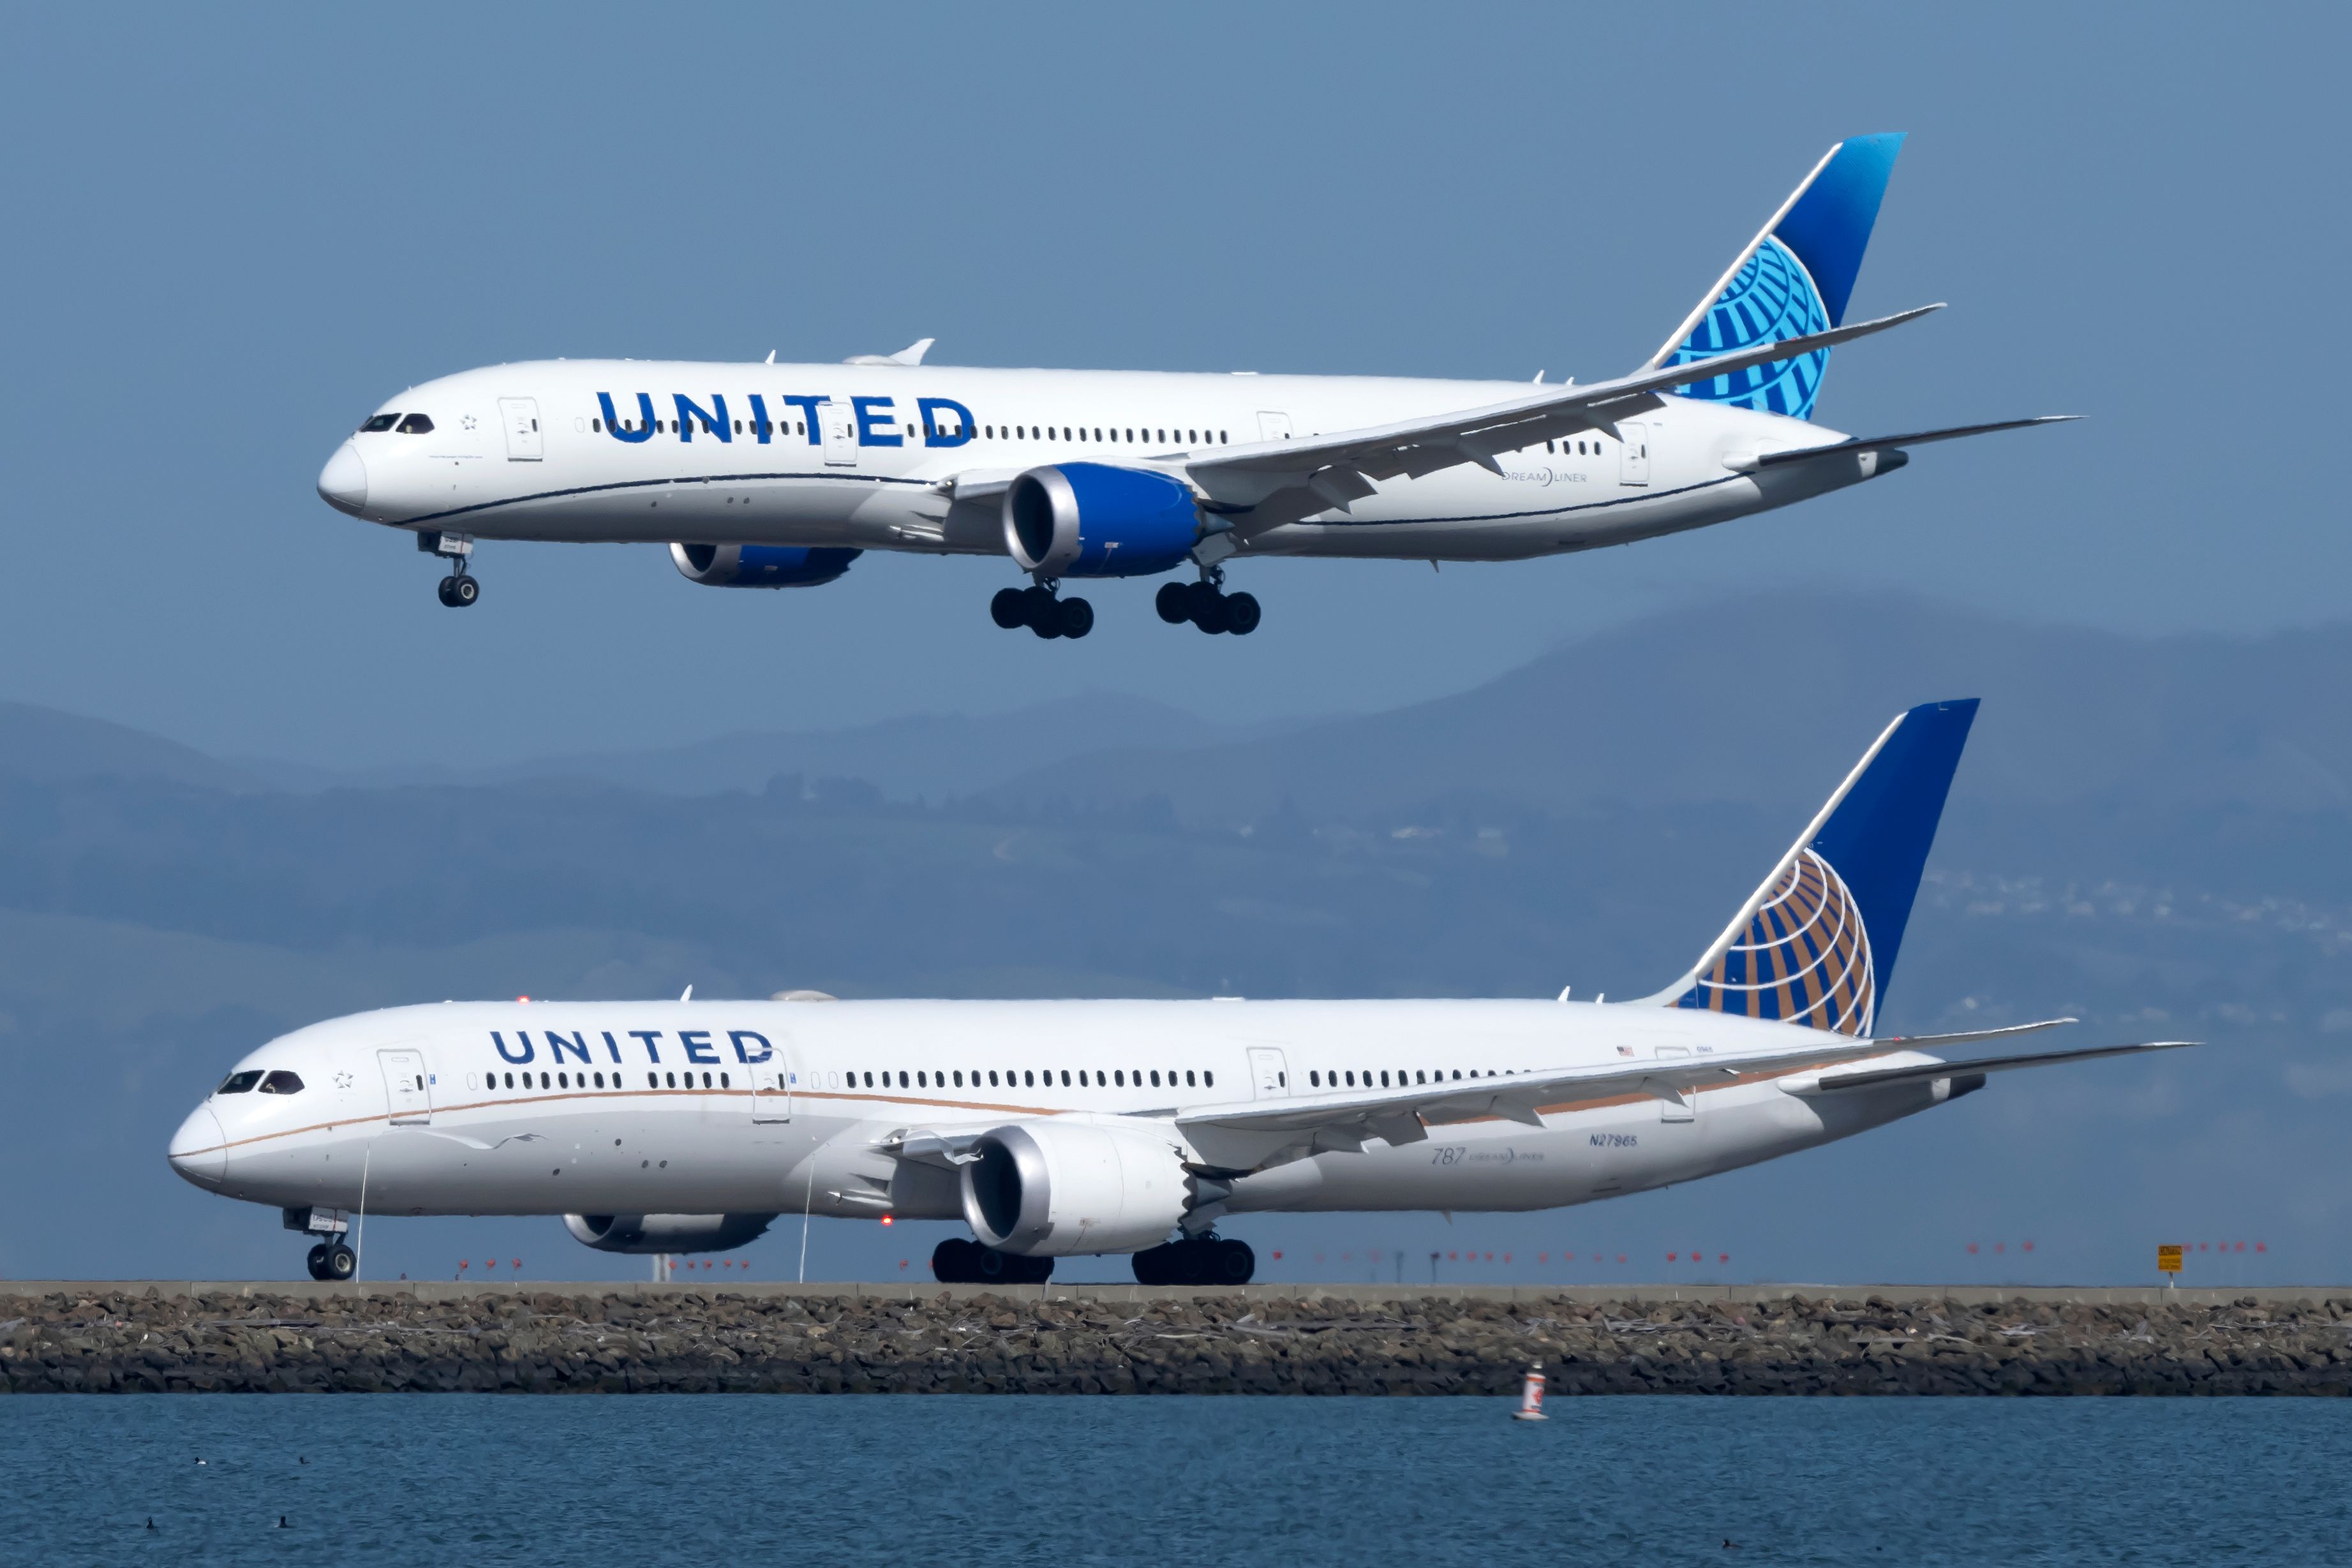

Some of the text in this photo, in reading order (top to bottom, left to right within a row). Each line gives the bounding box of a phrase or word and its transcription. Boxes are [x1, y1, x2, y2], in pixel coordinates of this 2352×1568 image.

[596, 392, 975, 448] UNITED
[489, 1031, 773, 1064] UNITED
[1590, 1134, 1638, 1147] N27965
[1432, 1147, 1466, 1165] 787
